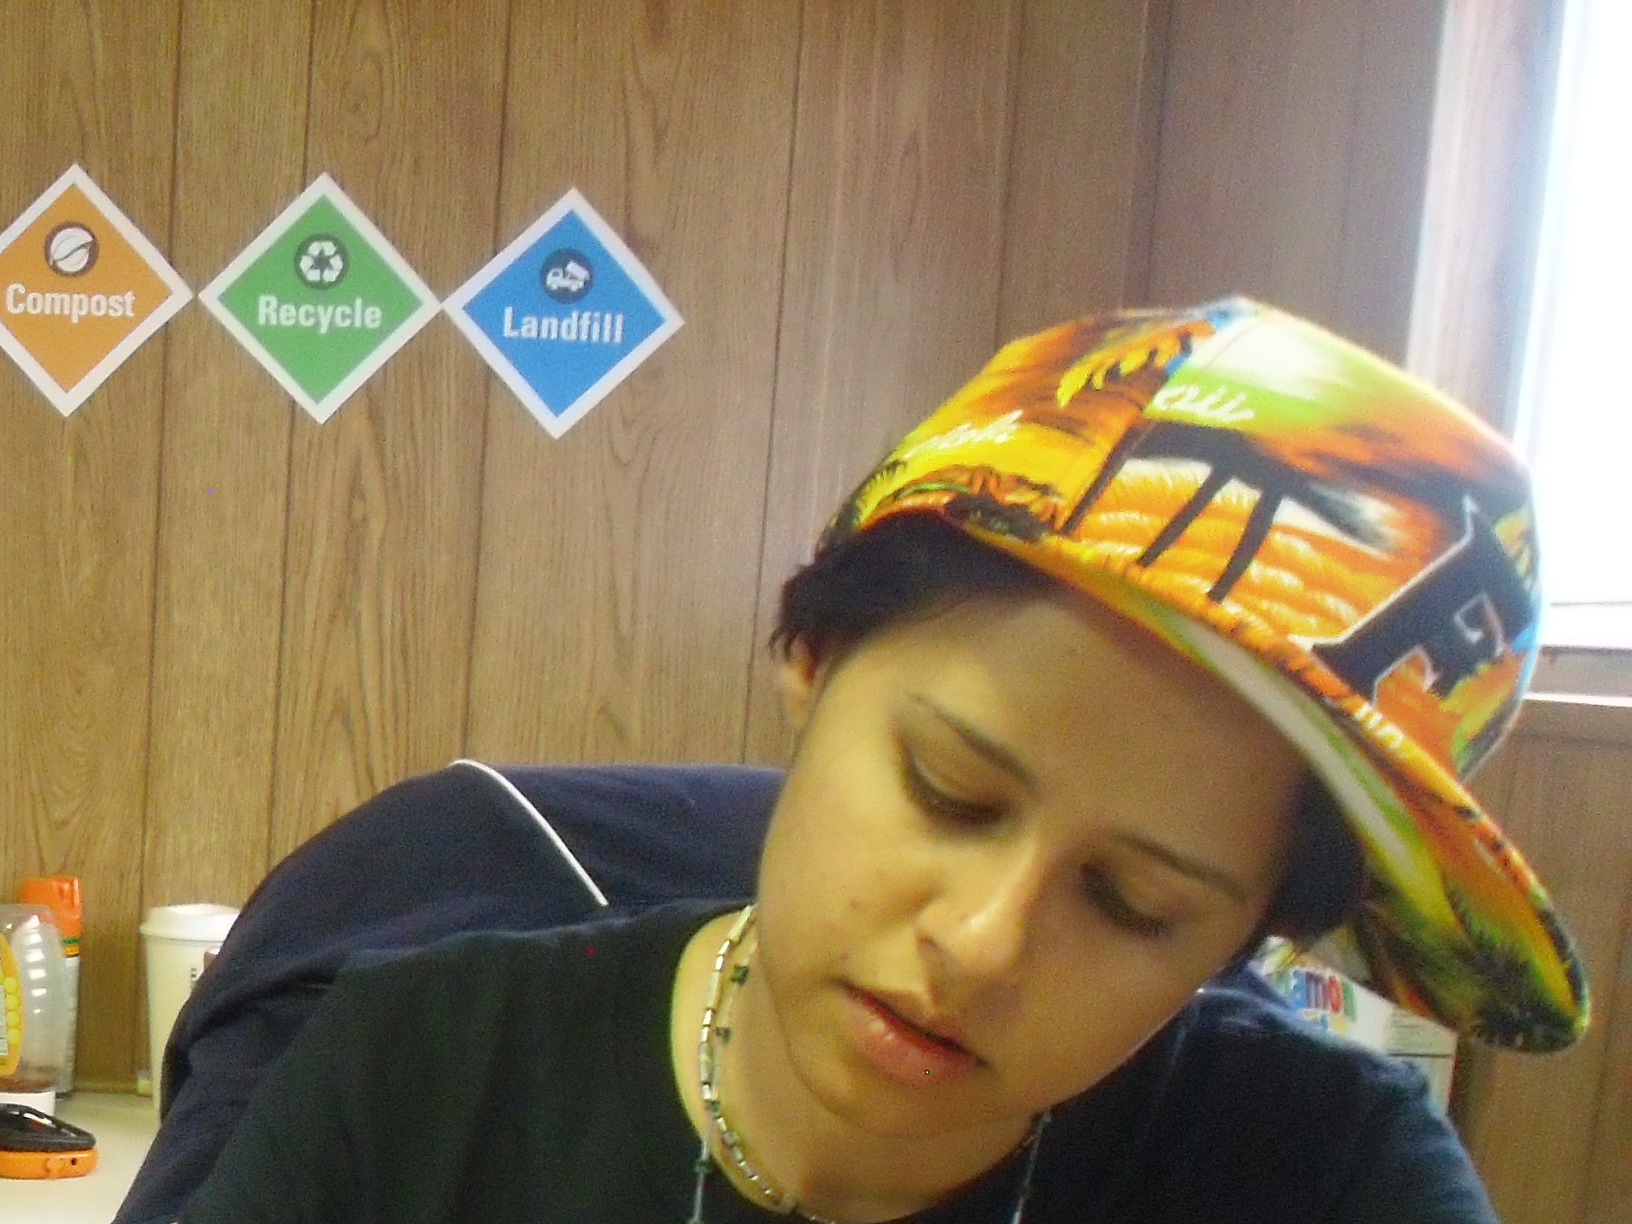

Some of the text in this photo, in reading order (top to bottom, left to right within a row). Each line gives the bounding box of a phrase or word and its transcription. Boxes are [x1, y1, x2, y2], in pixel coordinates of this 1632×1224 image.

[5, 283, 137, 323] Compost
[257, 296, 384, 334] Recycle
[503, 307, 625, 344] Landfill
